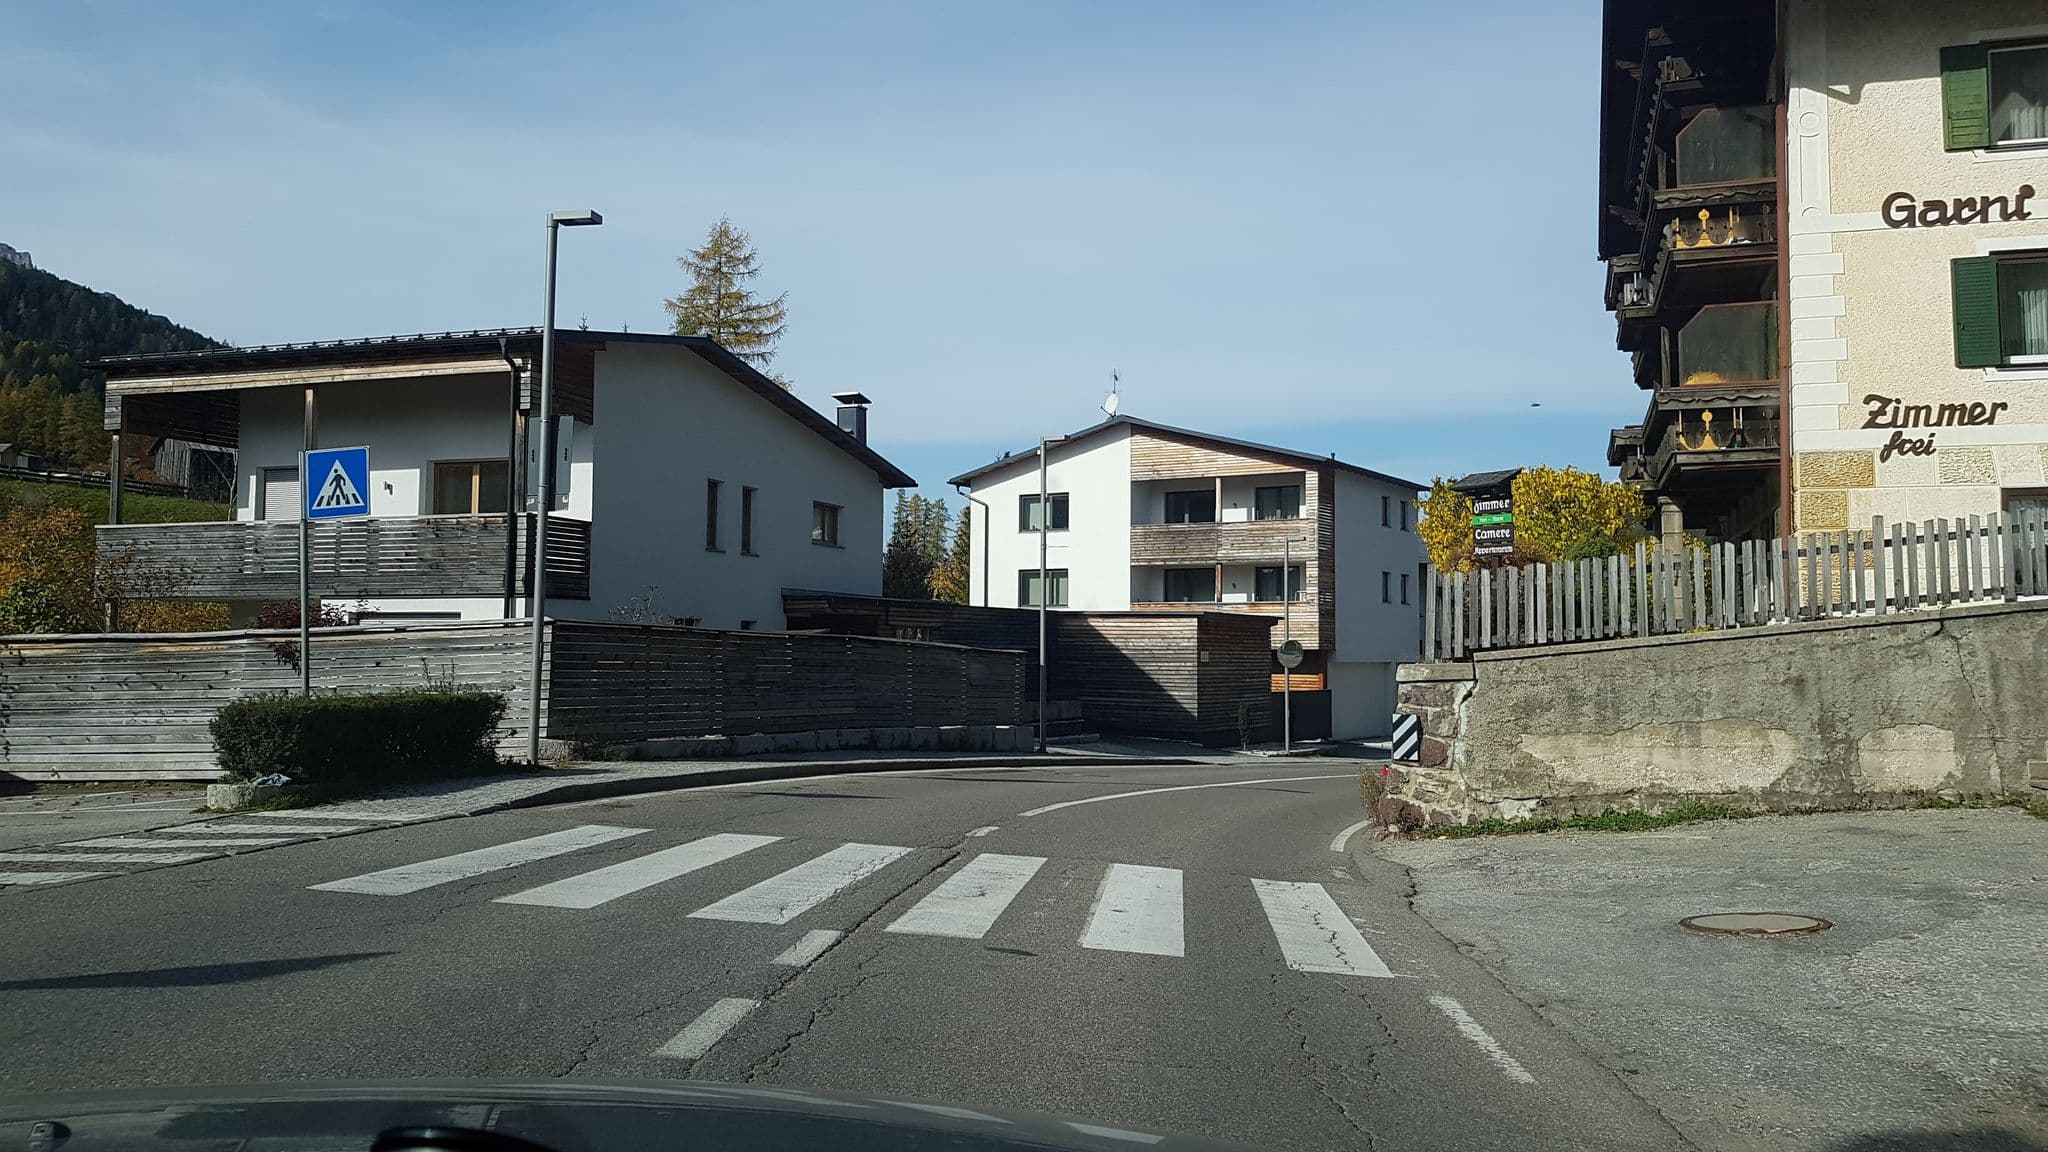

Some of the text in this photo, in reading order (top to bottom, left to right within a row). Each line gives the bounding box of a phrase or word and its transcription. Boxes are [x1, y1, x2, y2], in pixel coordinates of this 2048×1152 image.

[1881, 184, 2035, 228] Garni
[1860, 394, 2008, 429] Zimmer
[1880, 431, 1936, 463] frei
[1475, 529, 1511, 540] Camere
